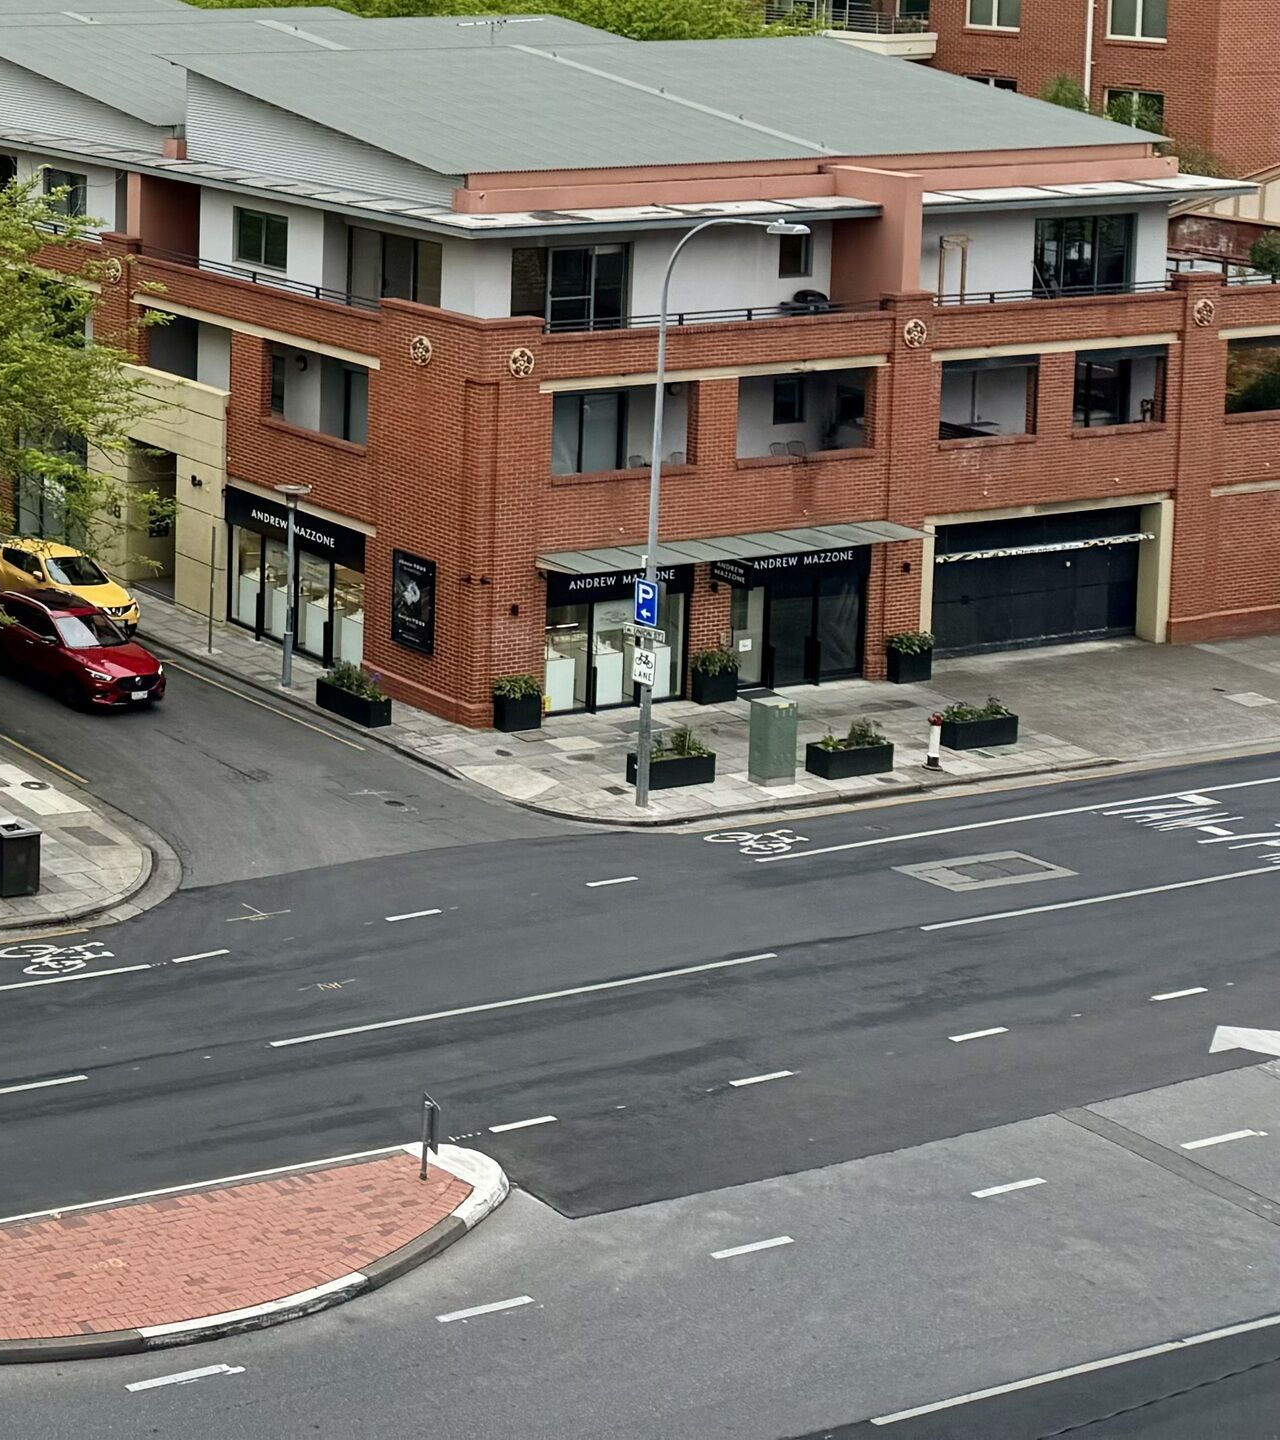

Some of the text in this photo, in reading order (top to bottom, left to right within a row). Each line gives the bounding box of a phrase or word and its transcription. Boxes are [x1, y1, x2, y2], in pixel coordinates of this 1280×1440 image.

[251, 509, 336, 548] ANDREW MAZZONE
[716, 561, 744, 575] ANDREW
[753, 550, 854, 570] ANDREW MAZZONE
[569, 569, 676, 590] ANDREW MAZONE
[714, 568, 746, 585] MAZZONE
[638, 583, 654, 605] P
[634, 669, 652, 682] LANE
